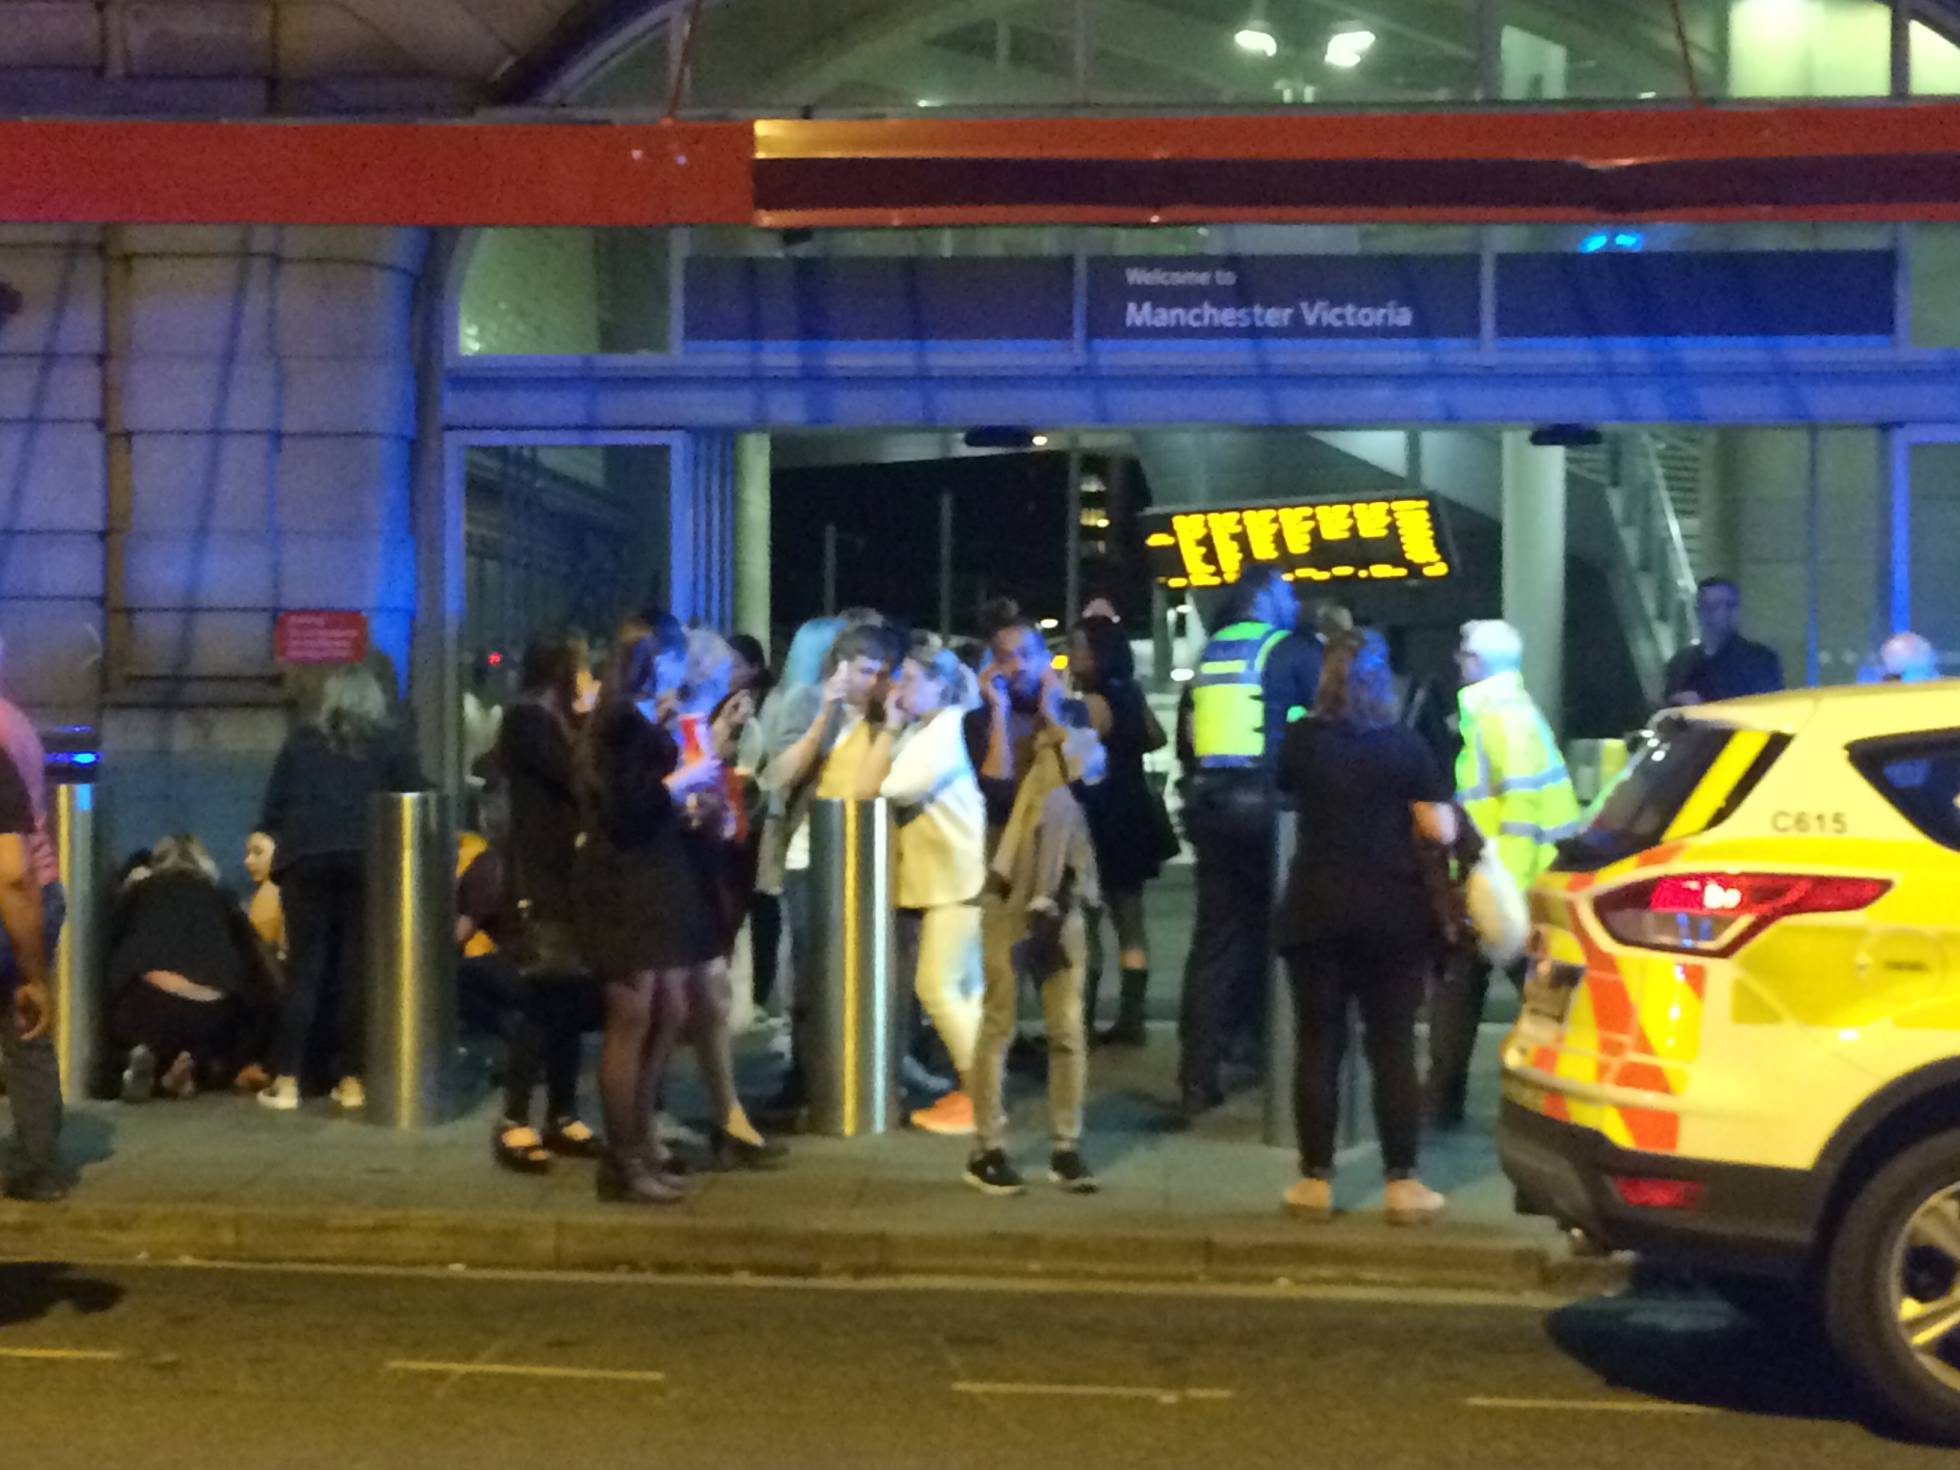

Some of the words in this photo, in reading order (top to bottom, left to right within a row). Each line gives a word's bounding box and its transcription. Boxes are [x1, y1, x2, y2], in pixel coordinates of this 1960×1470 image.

[1126, 268, 1211, 286] Welcome
[1215, 269, 1237, 286] to
[1126, 301, 1294, 327] Manchester
[1300, 300, 1413, 327] Victoria
[1771, 810, 1848, 834] C615
